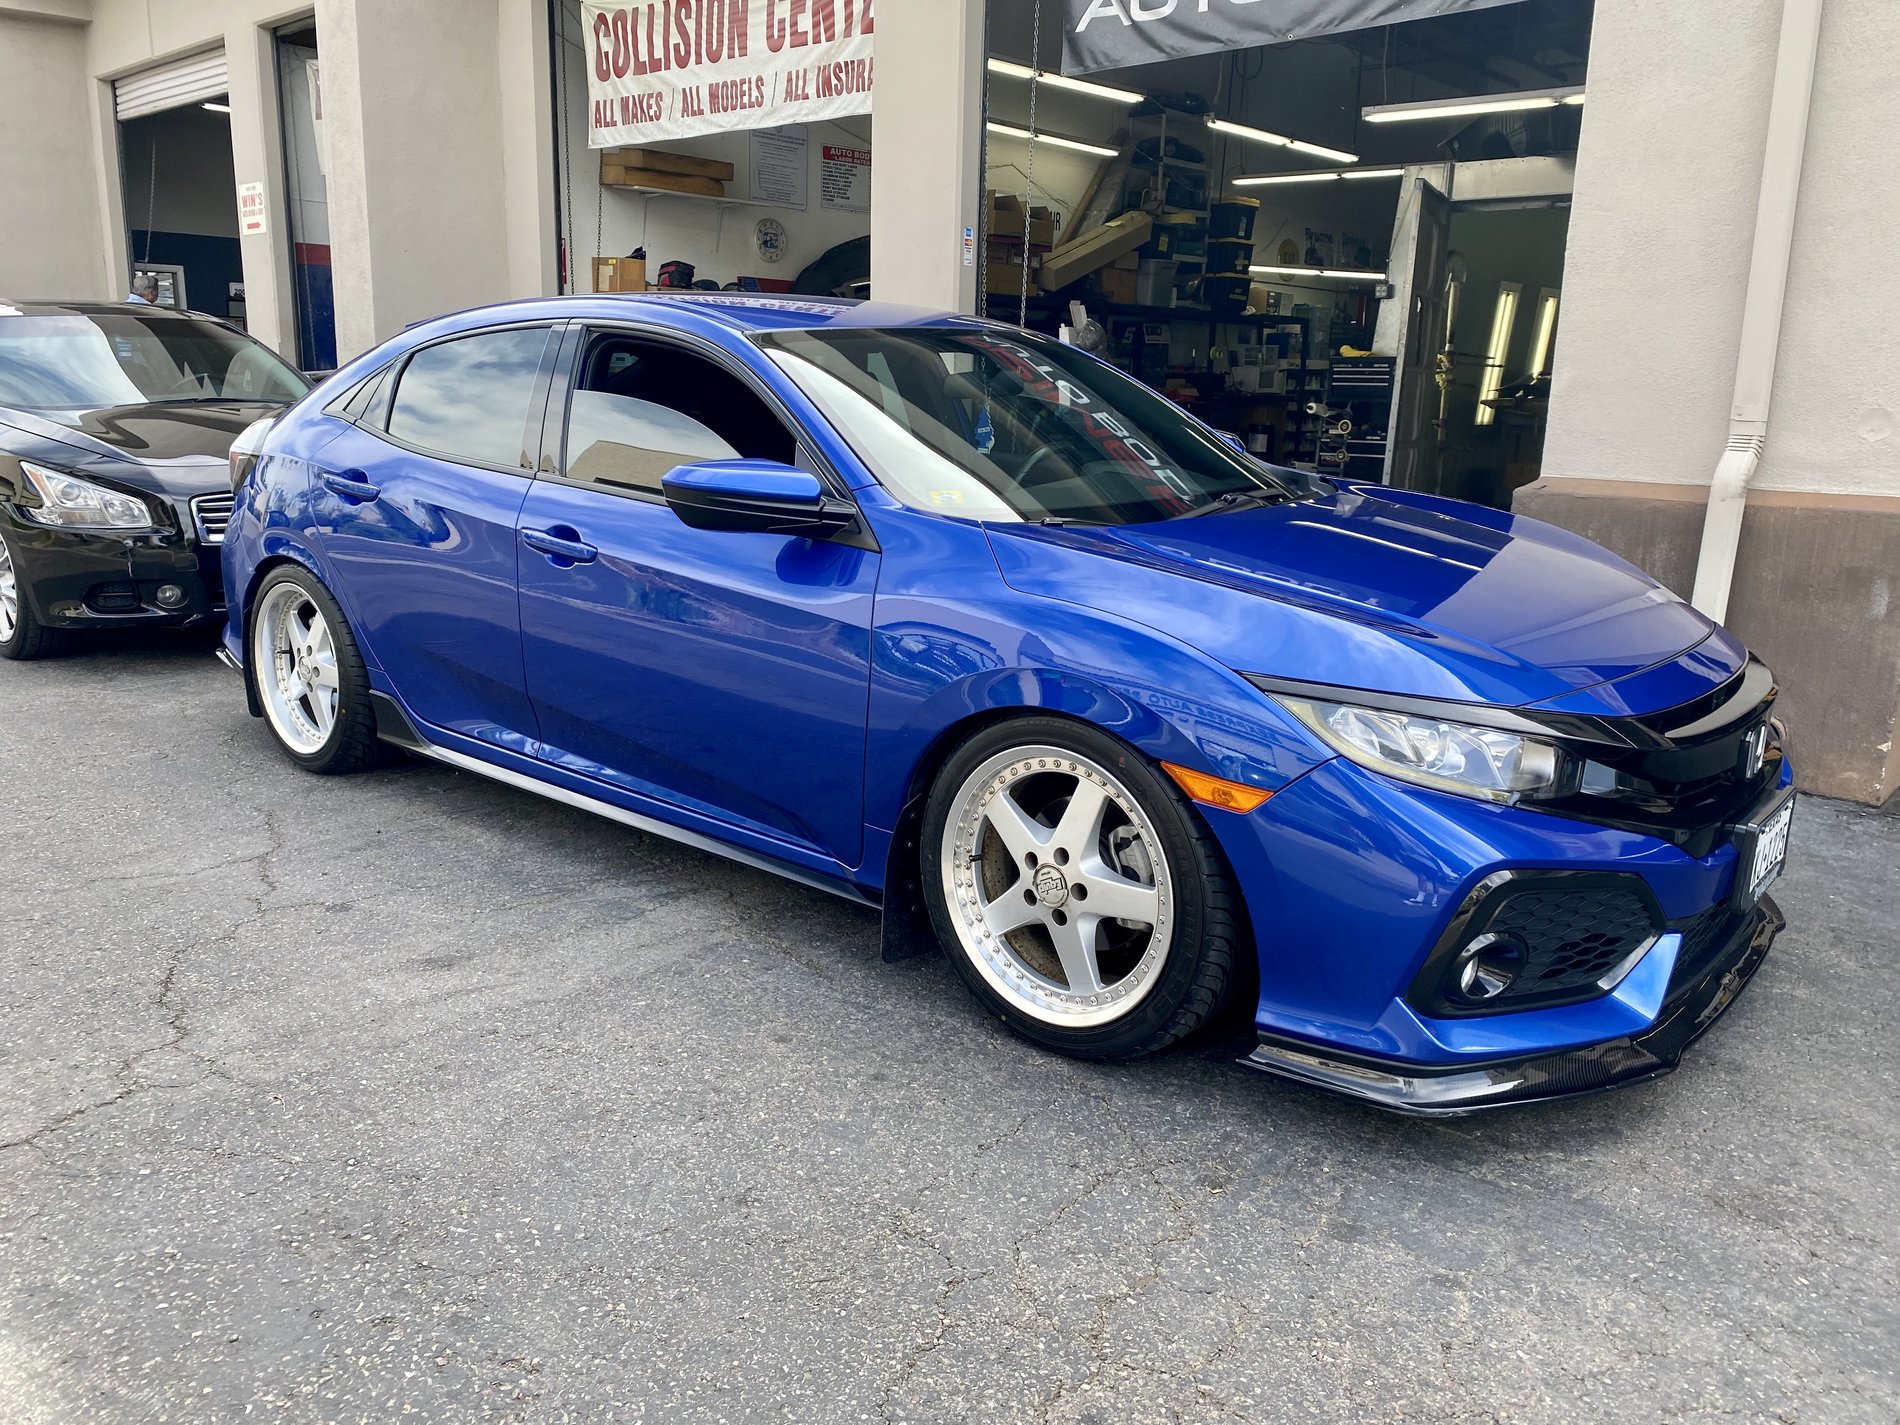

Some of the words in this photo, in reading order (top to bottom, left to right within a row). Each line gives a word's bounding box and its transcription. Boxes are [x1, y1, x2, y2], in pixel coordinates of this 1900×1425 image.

[593, 0, 748, 82] COLLISION
[766, 0, 874, 53] CENT
[594, 99, 617, 129] ALL
[620, 91, 663, 126] MAKES
[681, 85, 704, 118] ALL
[708, 75, 764, 114] MODELS
[784, 68, 809, 103] ALL
[830, 147, 853, 157] AUTO
[854, 151, 871, 160] BOD
